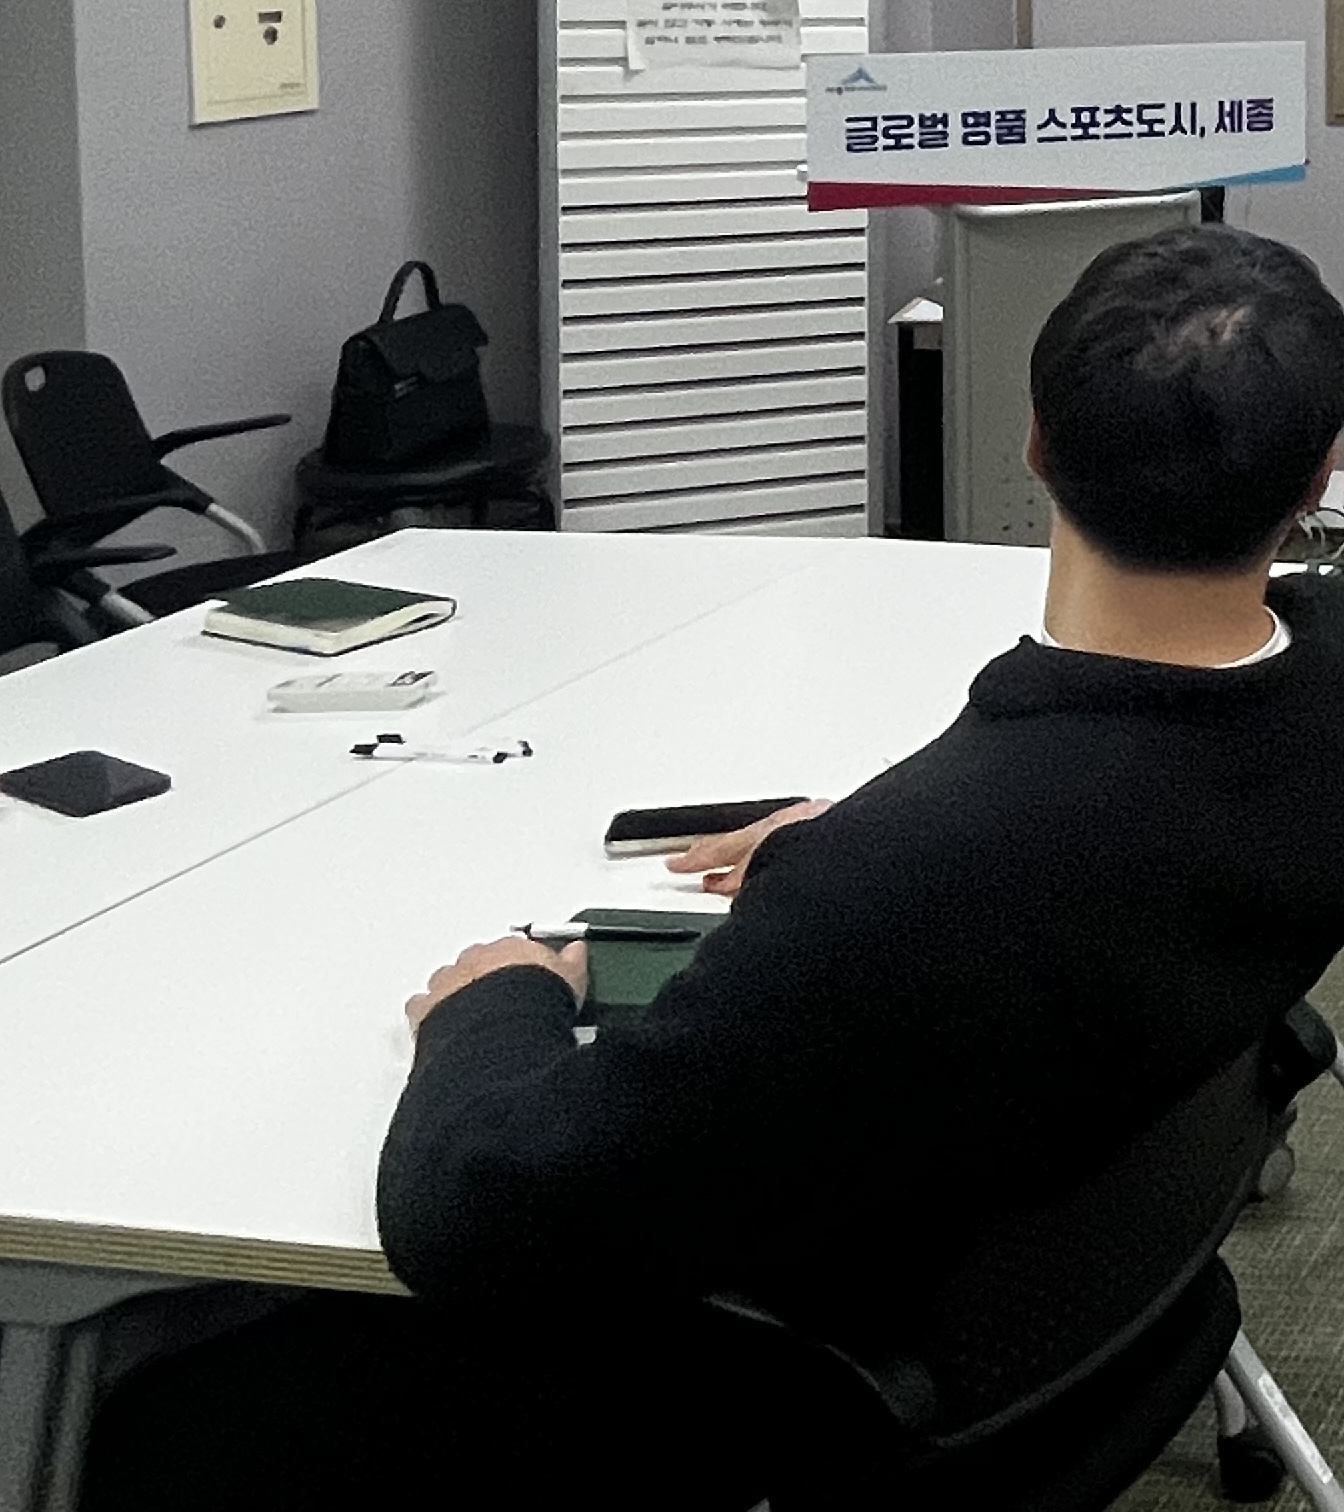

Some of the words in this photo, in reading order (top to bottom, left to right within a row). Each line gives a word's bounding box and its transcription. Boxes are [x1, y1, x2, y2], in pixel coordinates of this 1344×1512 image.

[844, 110, 951, 154] 글로벌
[959, 108, 1028, 147] 명품
[1036, 101, 1207, 144] 스포츠도시,
[1213, 96, 1276, 135] 세종
